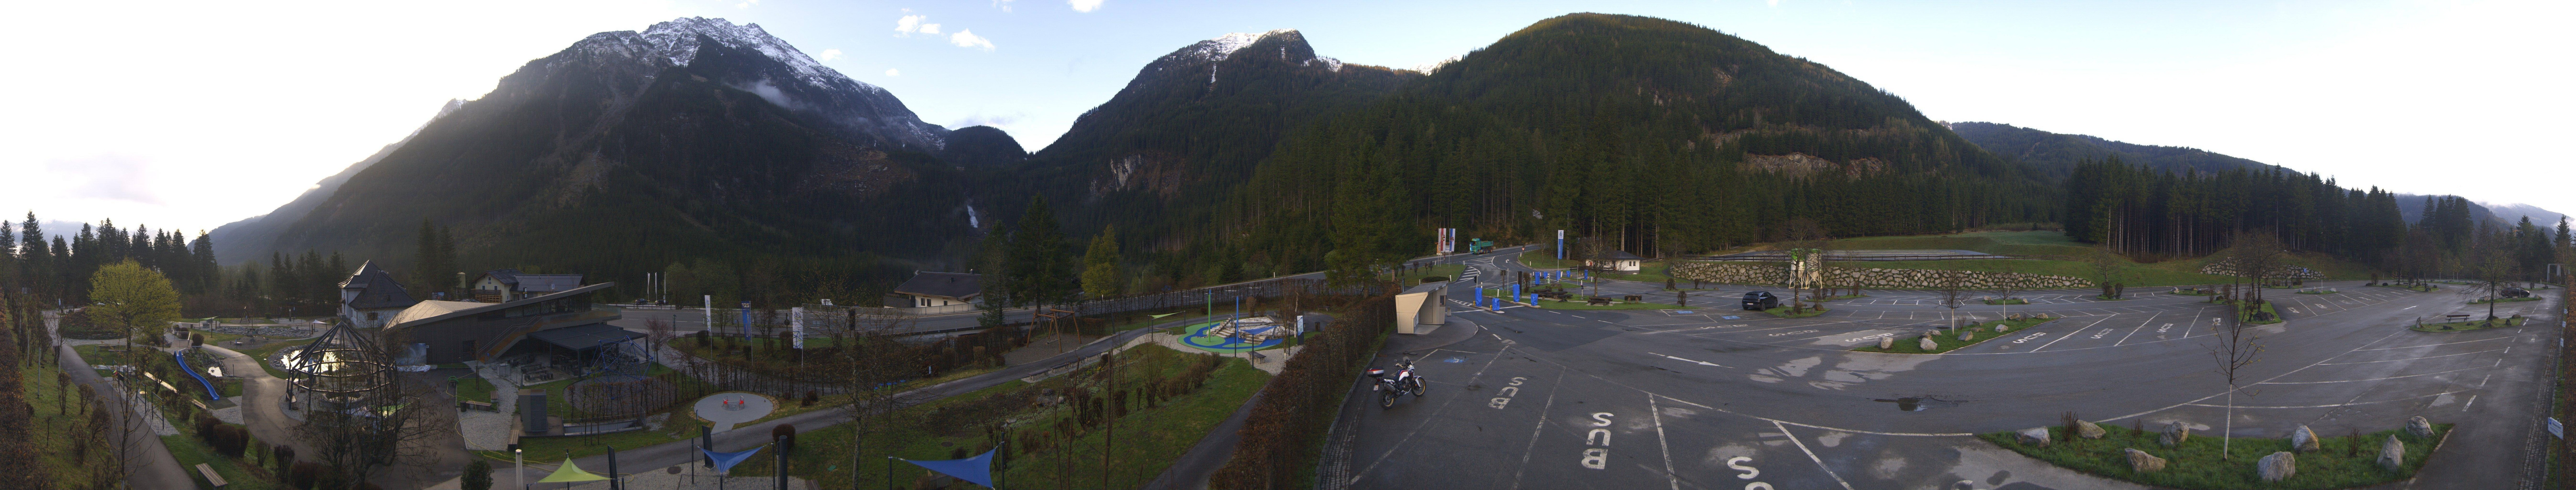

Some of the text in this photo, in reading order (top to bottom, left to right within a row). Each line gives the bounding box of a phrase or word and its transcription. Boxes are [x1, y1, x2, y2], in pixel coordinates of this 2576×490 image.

[2090, 328, 2114, 339] BUS
[2156, 323, 2174, 333] BUS
[1845, 333, 1893, 342] BUS
[2013, 333, 2046, 344] BUS
[1488, 377, 1527, 409] BUS
[1581, 412, 1614, 469] BUS
